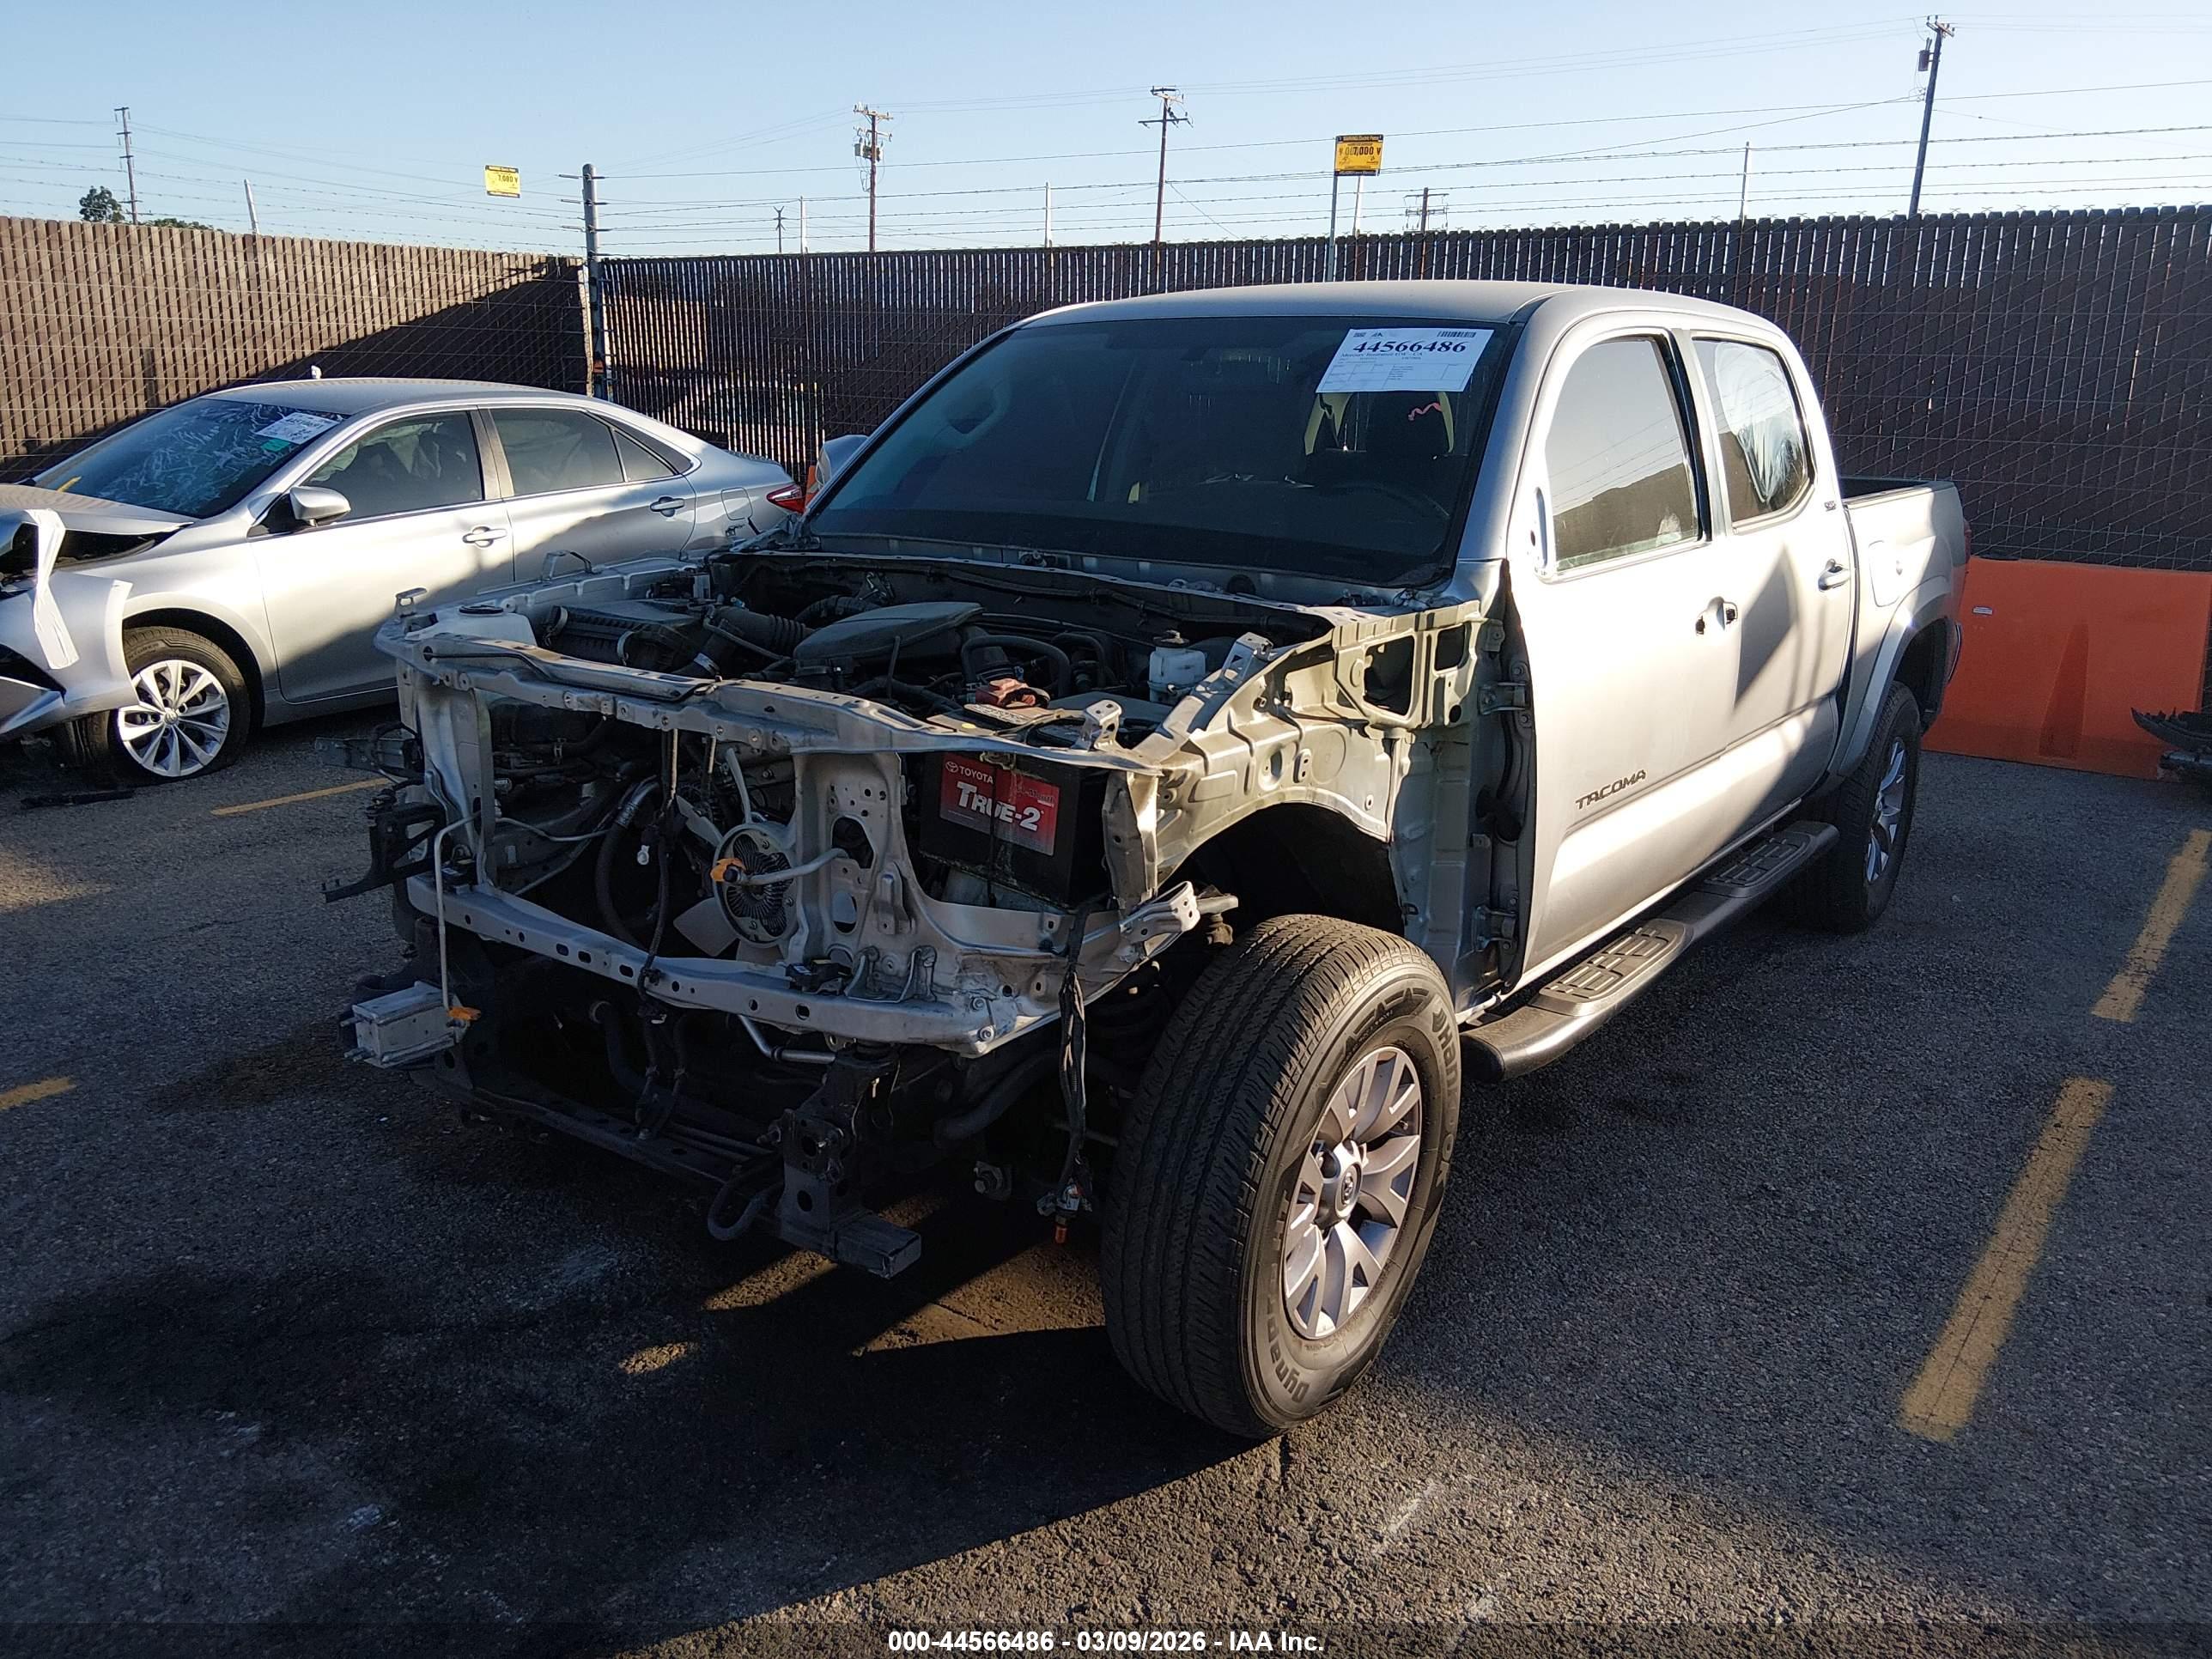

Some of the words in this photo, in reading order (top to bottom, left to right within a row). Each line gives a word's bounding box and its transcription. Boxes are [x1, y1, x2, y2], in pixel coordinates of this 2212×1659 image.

[1353, 340, 1470, 353] 44566486
[959, 764, 994, 785] TOYOTA
[1575, 769, 1647, 810] TACOMA
